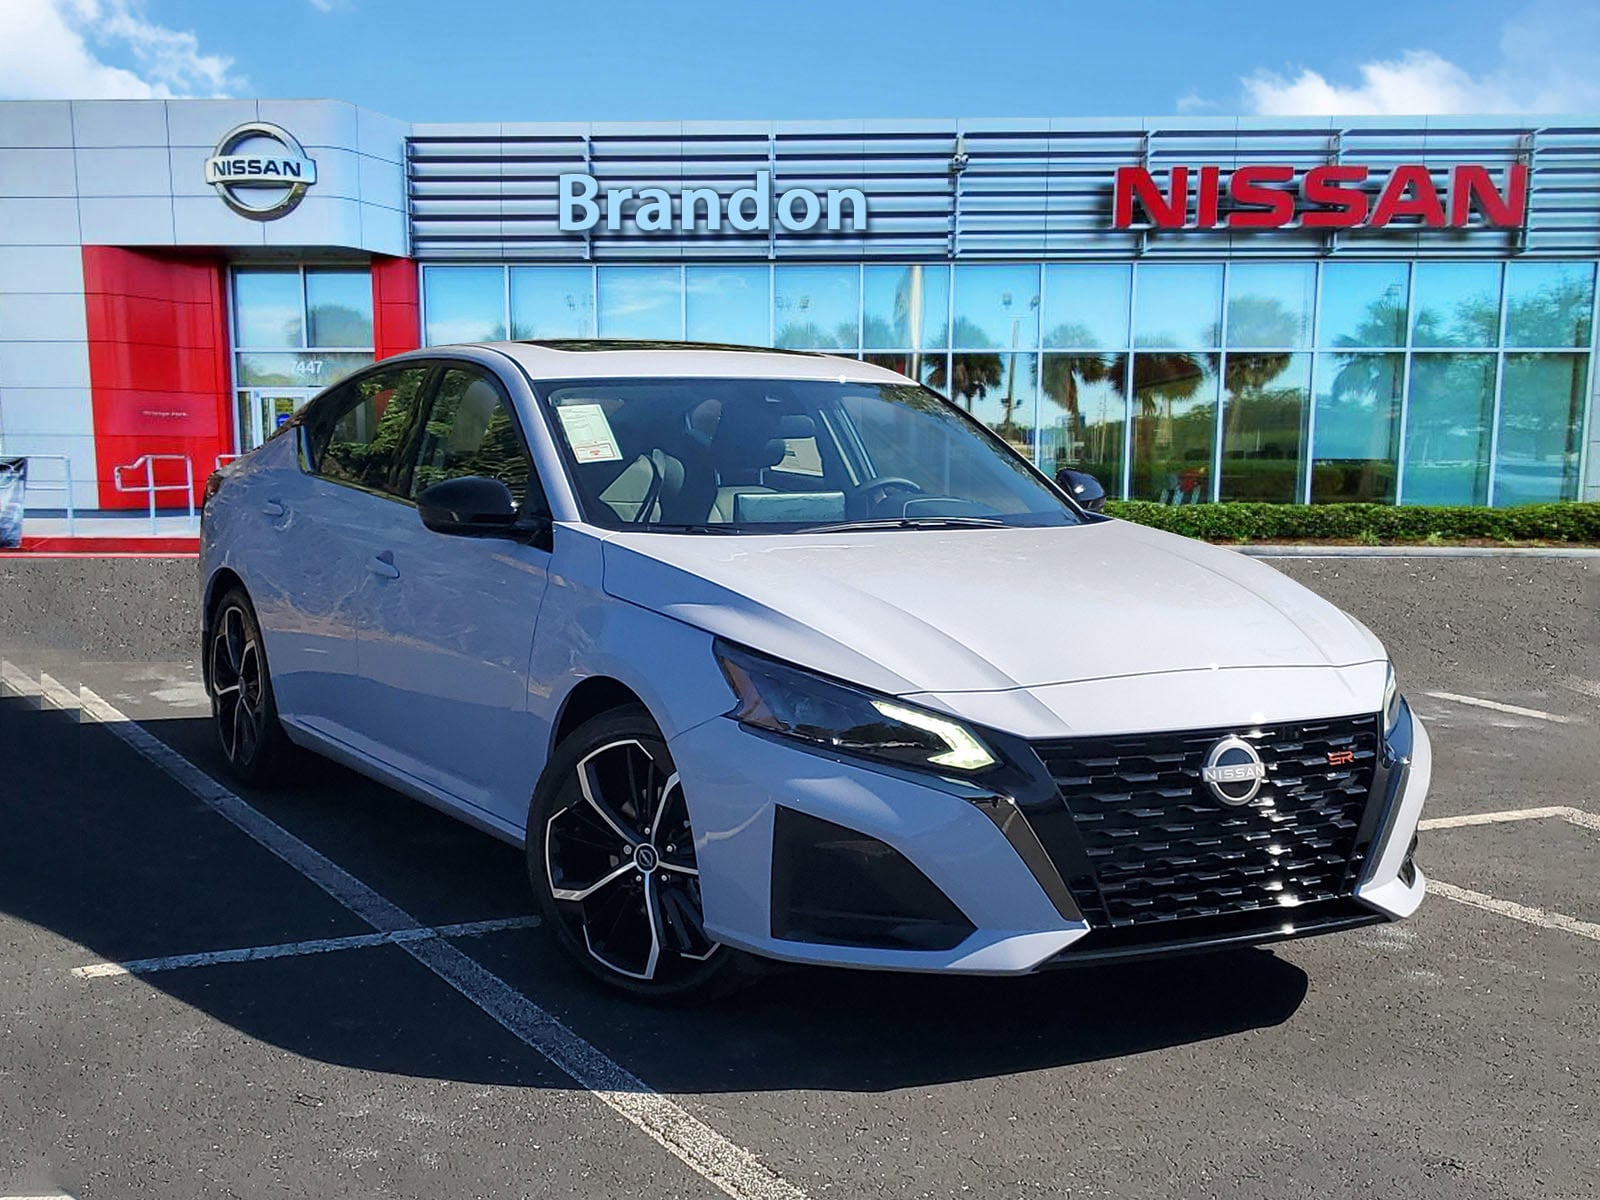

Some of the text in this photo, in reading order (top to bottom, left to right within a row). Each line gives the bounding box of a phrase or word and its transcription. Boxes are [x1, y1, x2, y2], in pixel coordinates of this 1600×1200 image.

[213, 159, 301, 177] NISSAN
[1112, 164, 1528, 229] NISSAN
[1327, 751, 1354, 766] SR
[1204, 767, 1265, 781] NISSAN
